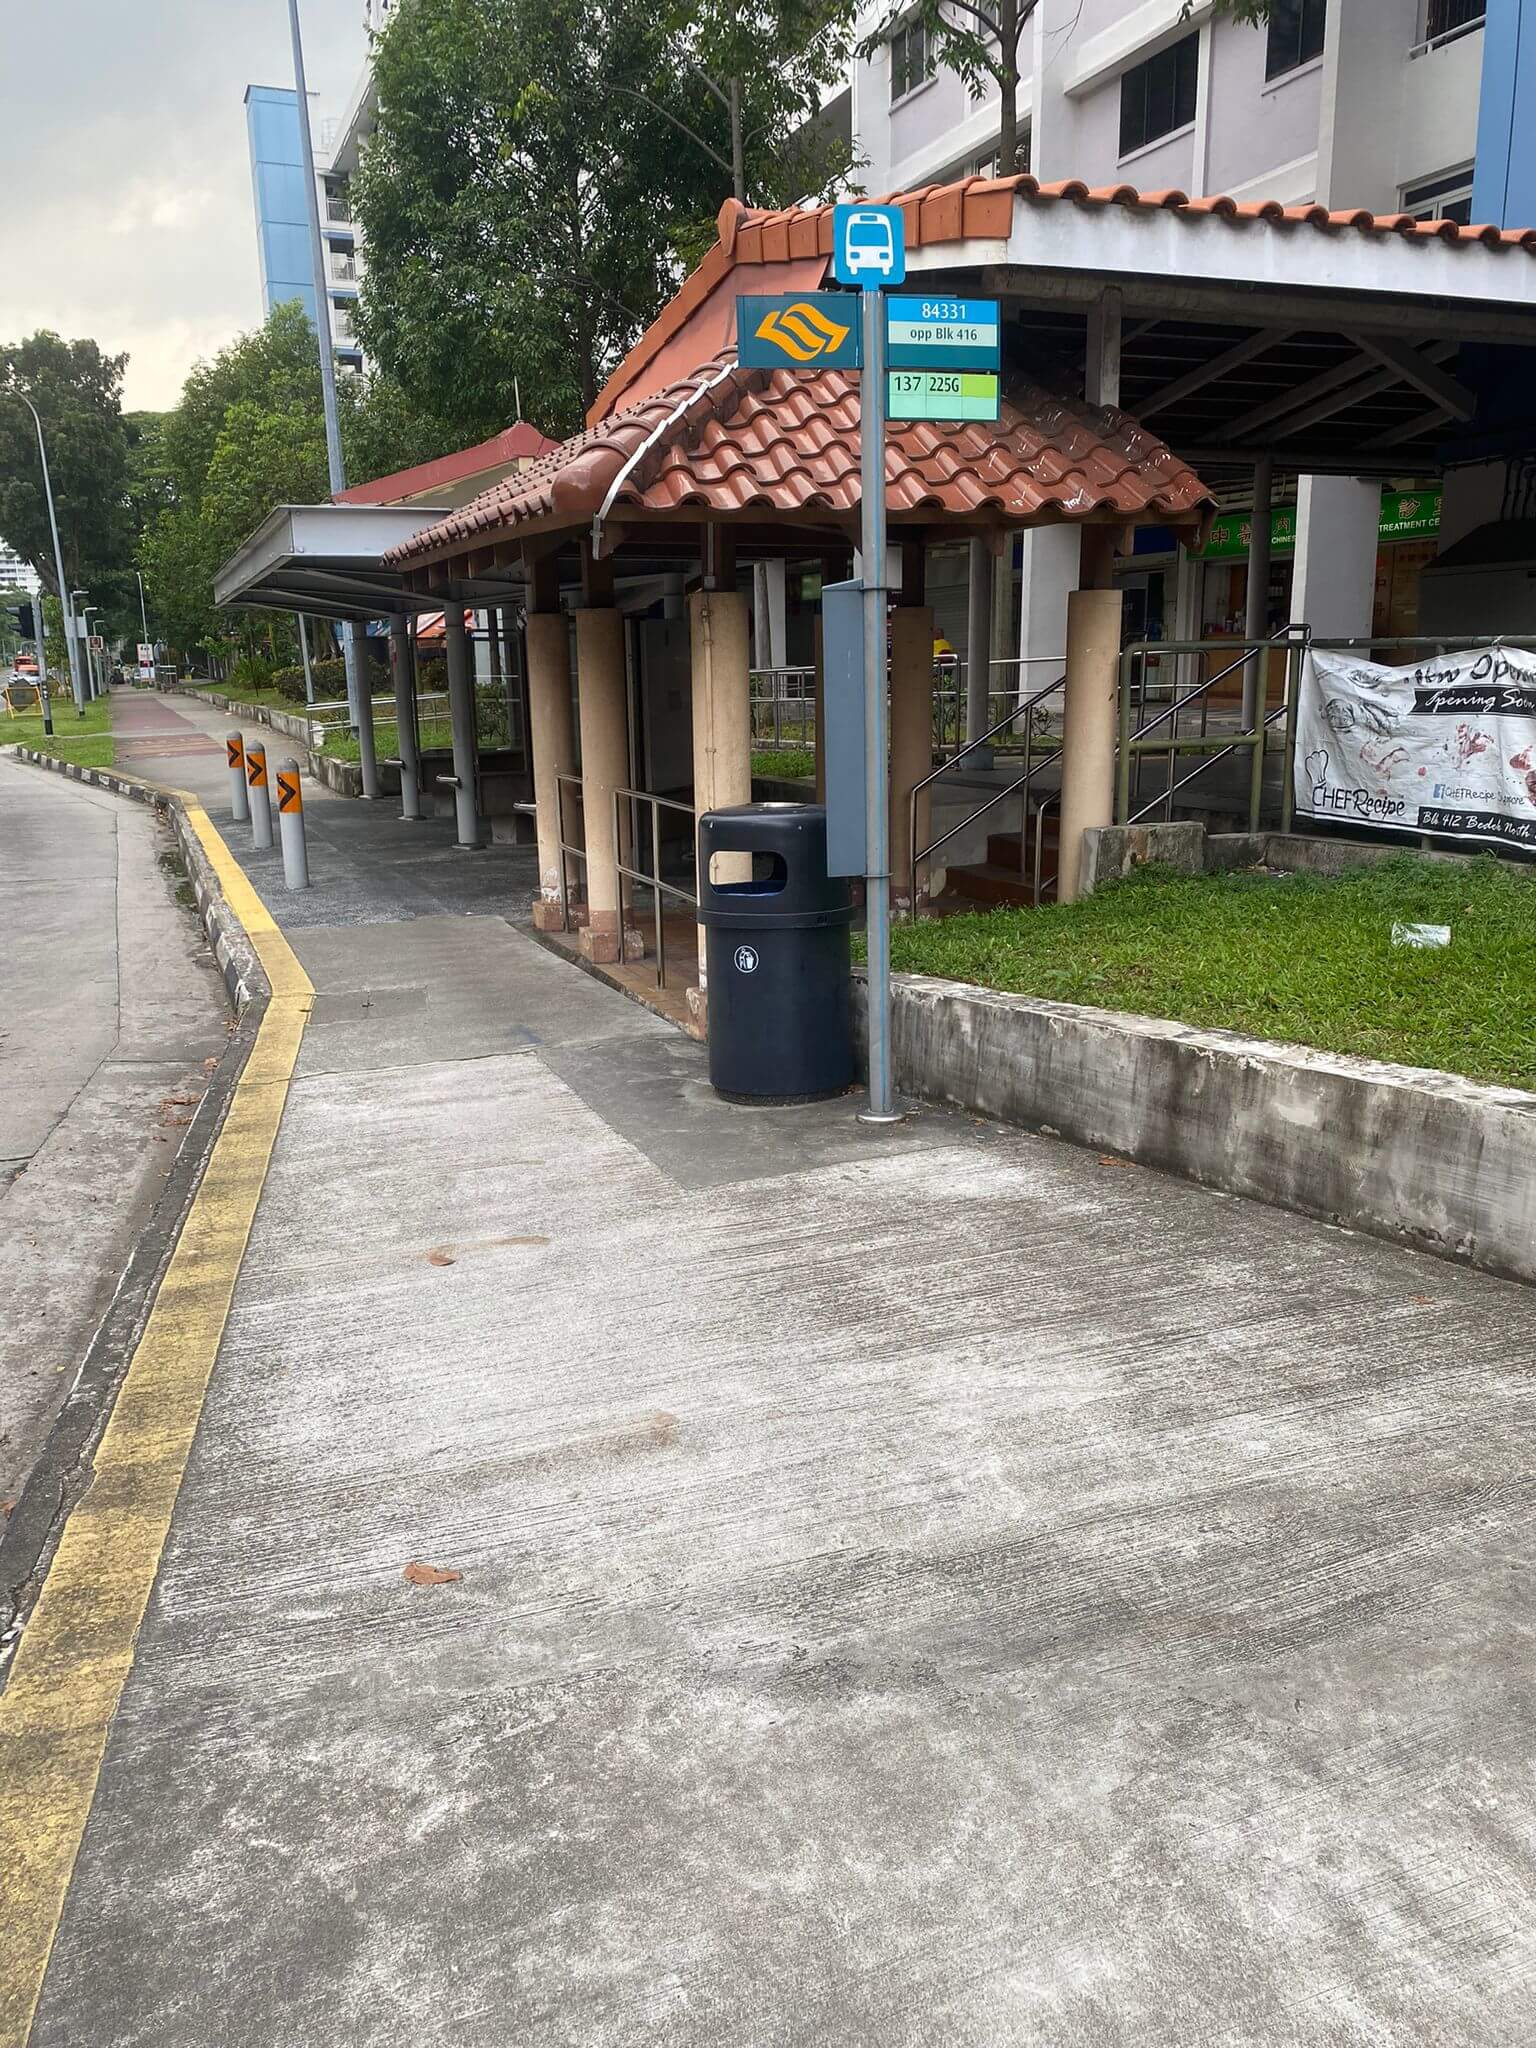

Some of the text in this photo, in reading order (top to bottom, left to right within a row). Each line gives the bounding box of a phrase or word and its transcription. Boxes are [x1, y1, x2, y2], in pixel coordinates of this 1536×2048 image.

[921, 302, 968, 320] 84331
[910, 327, 977, 341] opp Blk 416
[894, 376, 960, 392] 137 225G
[1379, 519, 1427, 533] TREATMENT
[1442, 813, 1461, 828] 412
